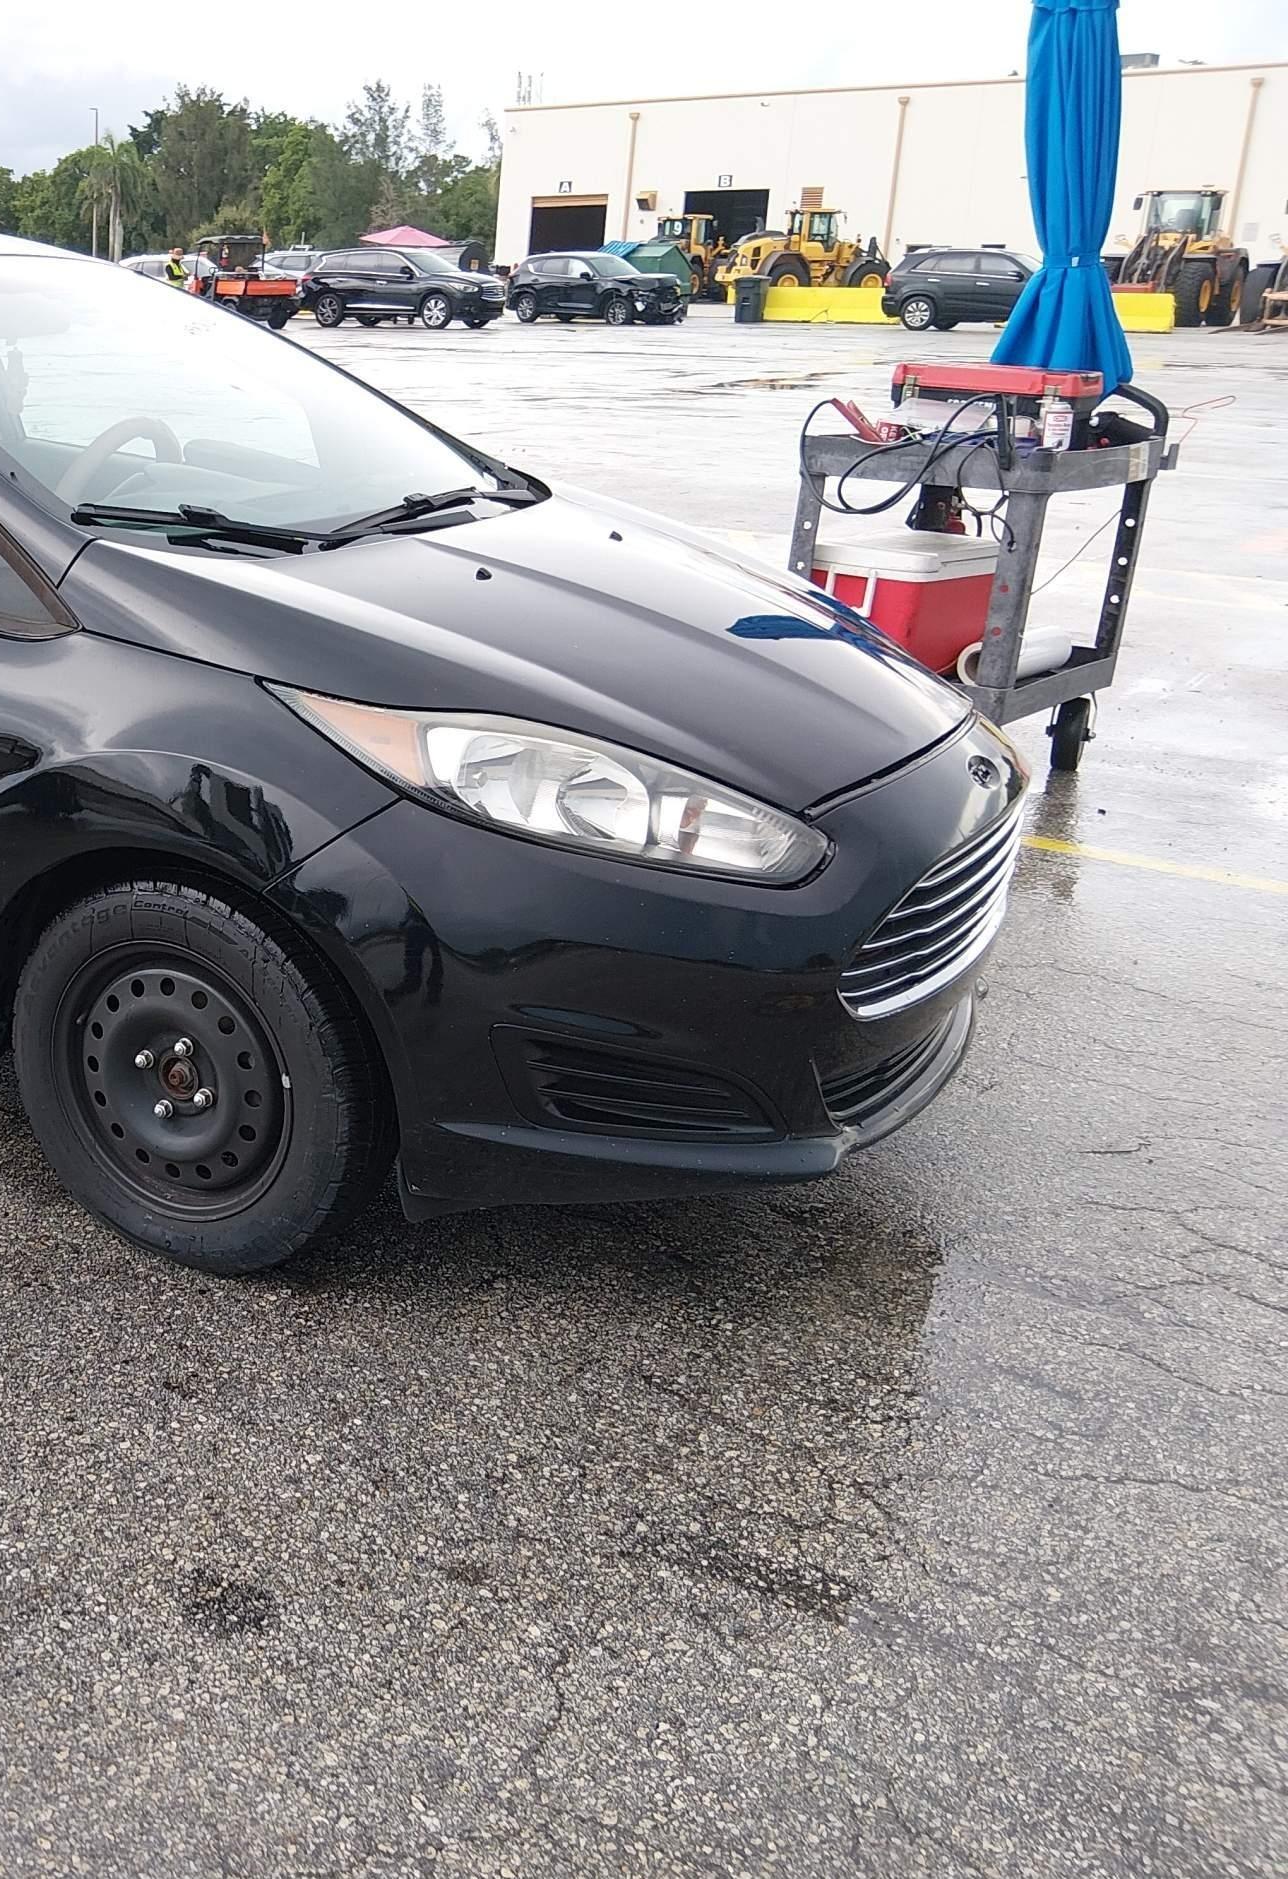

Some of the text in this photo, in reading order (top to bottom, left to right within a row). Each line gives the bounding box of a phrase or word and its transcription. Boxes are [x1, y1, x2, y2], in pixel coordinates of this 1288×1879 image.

[720, 176, 730, 187] B
[560, 182, 571, 193] A
[133, 900, 189, 917] Control
